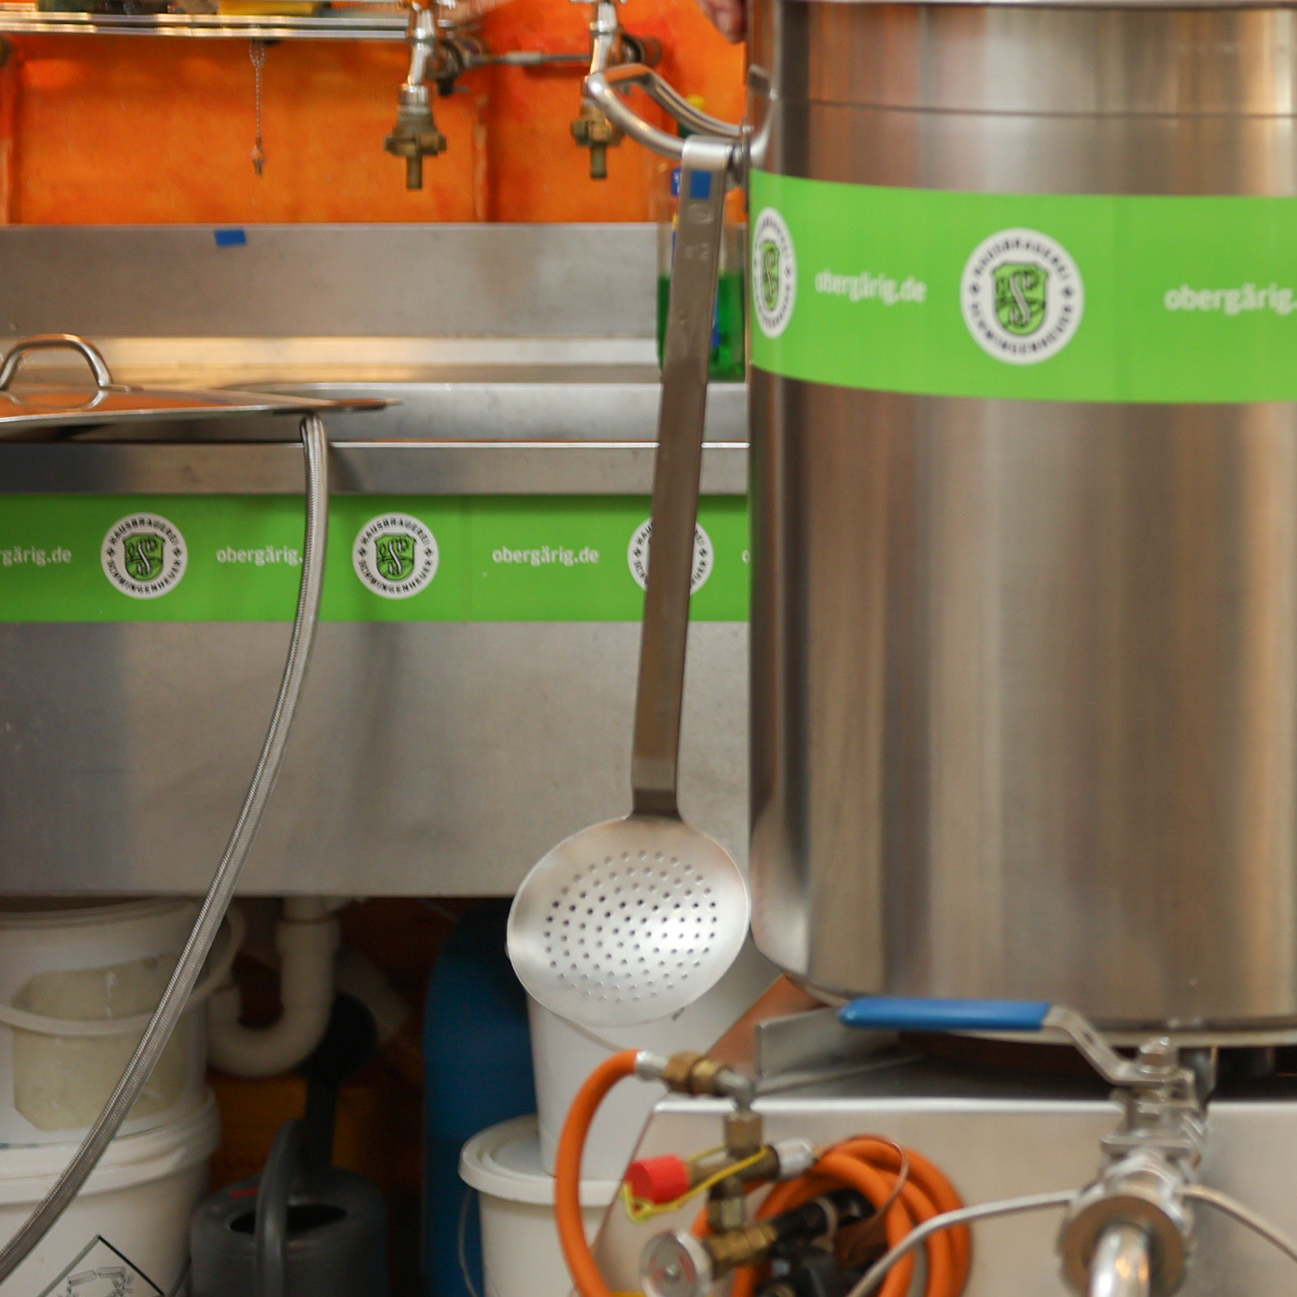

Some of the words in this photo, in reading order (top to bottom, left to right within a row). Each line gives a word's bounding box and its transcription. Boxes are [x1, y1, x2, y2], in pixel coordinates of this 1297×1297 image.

[814, 268, 928, 306] obergärig.de
[216, 544, 303, 567] obergärig.
[492, 546, 600, 567] obergärig.de
